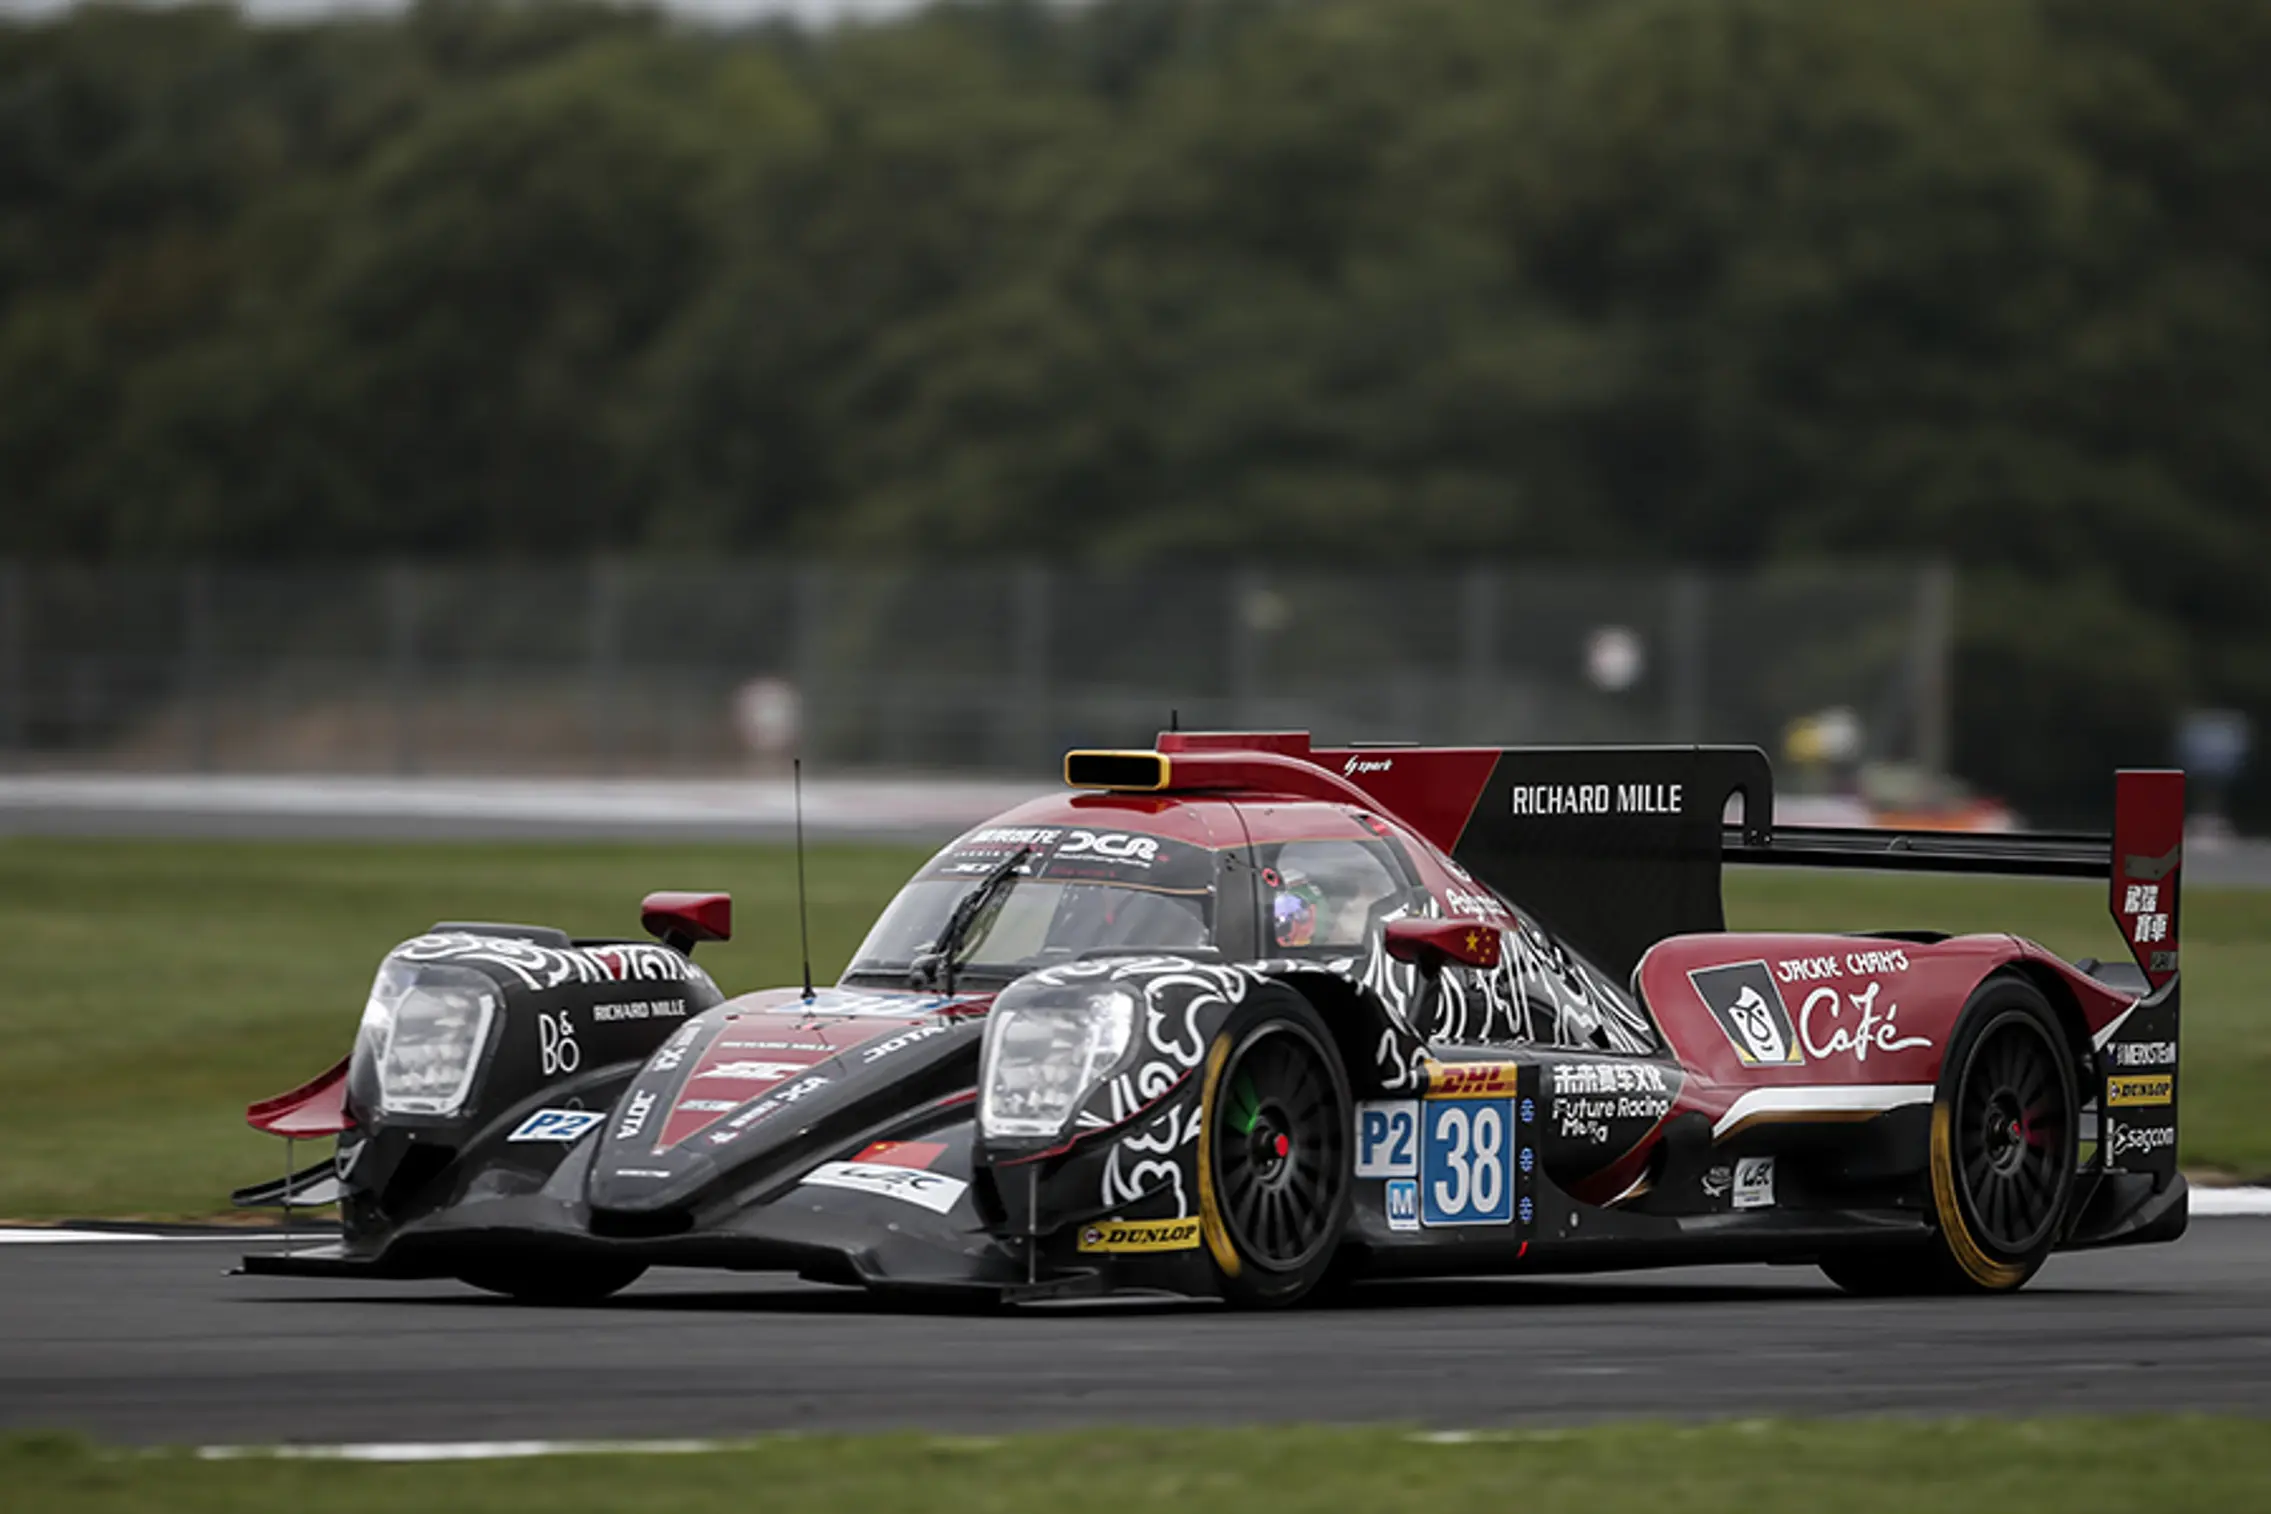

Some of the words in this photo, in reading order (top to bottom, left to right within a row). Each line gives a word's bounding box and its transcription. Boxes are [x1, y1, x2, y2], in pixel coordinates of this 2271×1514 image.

[1513, 786, 1609, 815] RICHARD
[1617, 784, 1682, 813] MILLE
[1777, 956, 1843, 982] JACKIE
[593, 1002, 649, 1021] RICHARD
[651, 999, 686, 1016] MILLE
[1800, 982, 1933, 1061] Café
[1439, 1066, 1505, 1094] DHL
[2121, 1082, 2169, 1097] DUNLOP
[1552, 1098, 1615, 1119] Future
[520, 1113, 591, 1135] P2
[1361, 1110, 1414, 1165] P2
[1434, 1107, 1502, 1215] 38
[1393, 1189, 1413, 1215] M
[1108, 1225, 1196, 1243] DUNLOP
